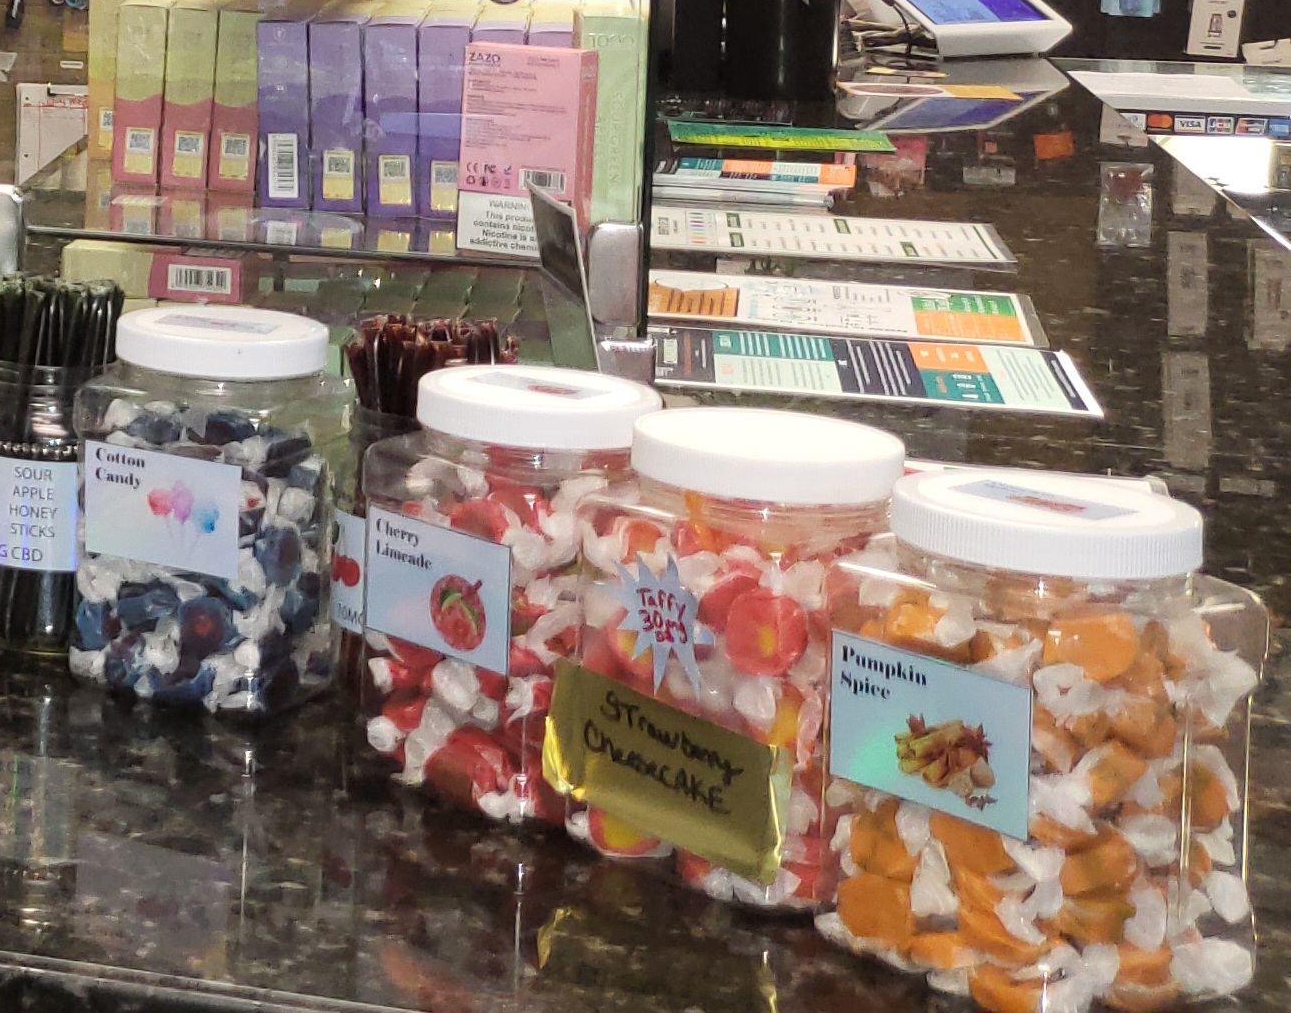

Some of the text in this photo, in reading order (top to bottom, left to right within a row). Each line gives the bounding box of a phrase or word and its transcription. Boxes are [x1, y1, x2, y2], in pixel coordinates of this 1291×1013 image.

[469, 51, 501, 64] ZAZO
[1179, 120, 1202, 129] VISA
[472, 219, 510, 230] contains
[482, 229, 518, 239] Nicotine
[469, 238, 509, 249] addictive
[95, 447, 146, 468] Cotton
[13, 466, 53, 482] SOUR
[94, 468, 142, 489] Candy
[12, 485, 55, 501] APPLE
[9, 504, 59, 521] HONEY
[9, 522, 56, 539] STICKS
[375, 517, 421, 548] Cherry
[10, 544, 44, 562] CBD
[375, 538, 434, 571] Limeade
[634, 588, 686, 619] Taffy
[638, 611, 689, 645] 30mg
[841, 644, 929, 689] Pumpkin
[839, 670, 893, 700] Spice
